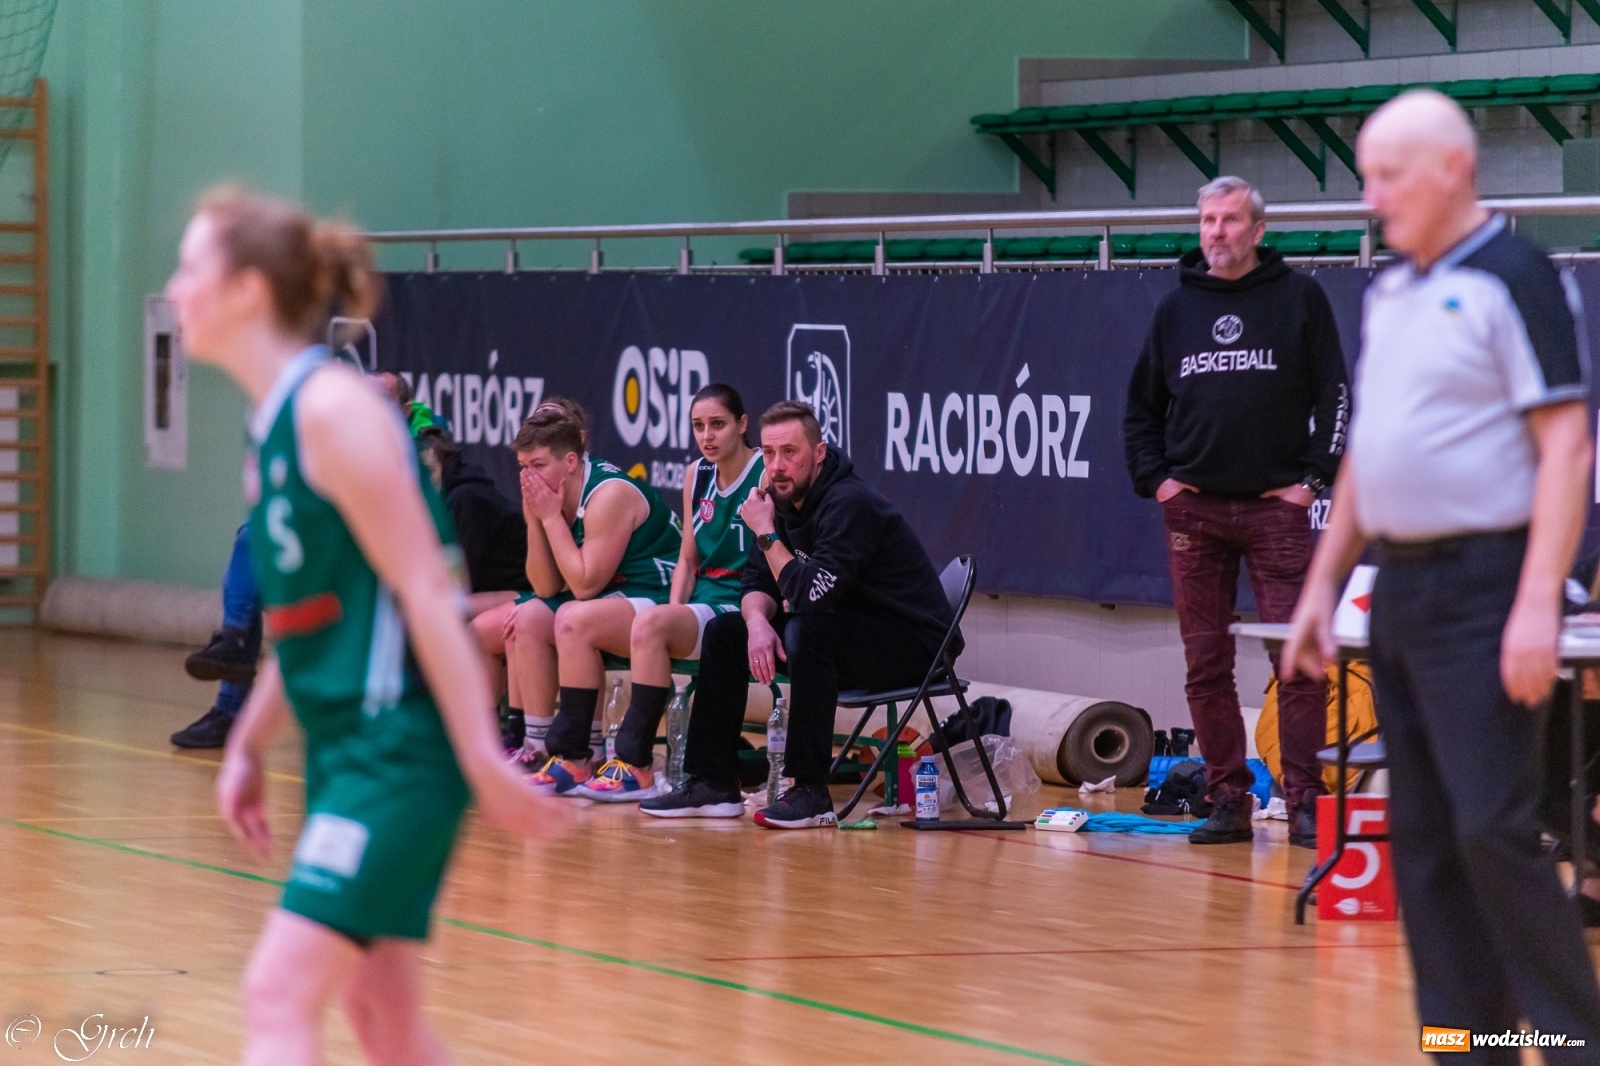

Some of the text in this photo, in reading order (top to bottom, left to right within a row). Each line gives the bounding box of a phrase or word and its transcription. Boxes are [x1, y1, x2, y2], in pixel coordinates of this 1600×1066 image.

[1180, 348, 1278, 378] BASKETBALL
[400, 349, 545, 447] ACIBÓRZ
[885, 362, 1091, 478] RACIBÓRZ
[651, 456, 691, 490] RACIB
[819, 816, 836, 826] FILA
[1330, 809, 1386, 889] 5
